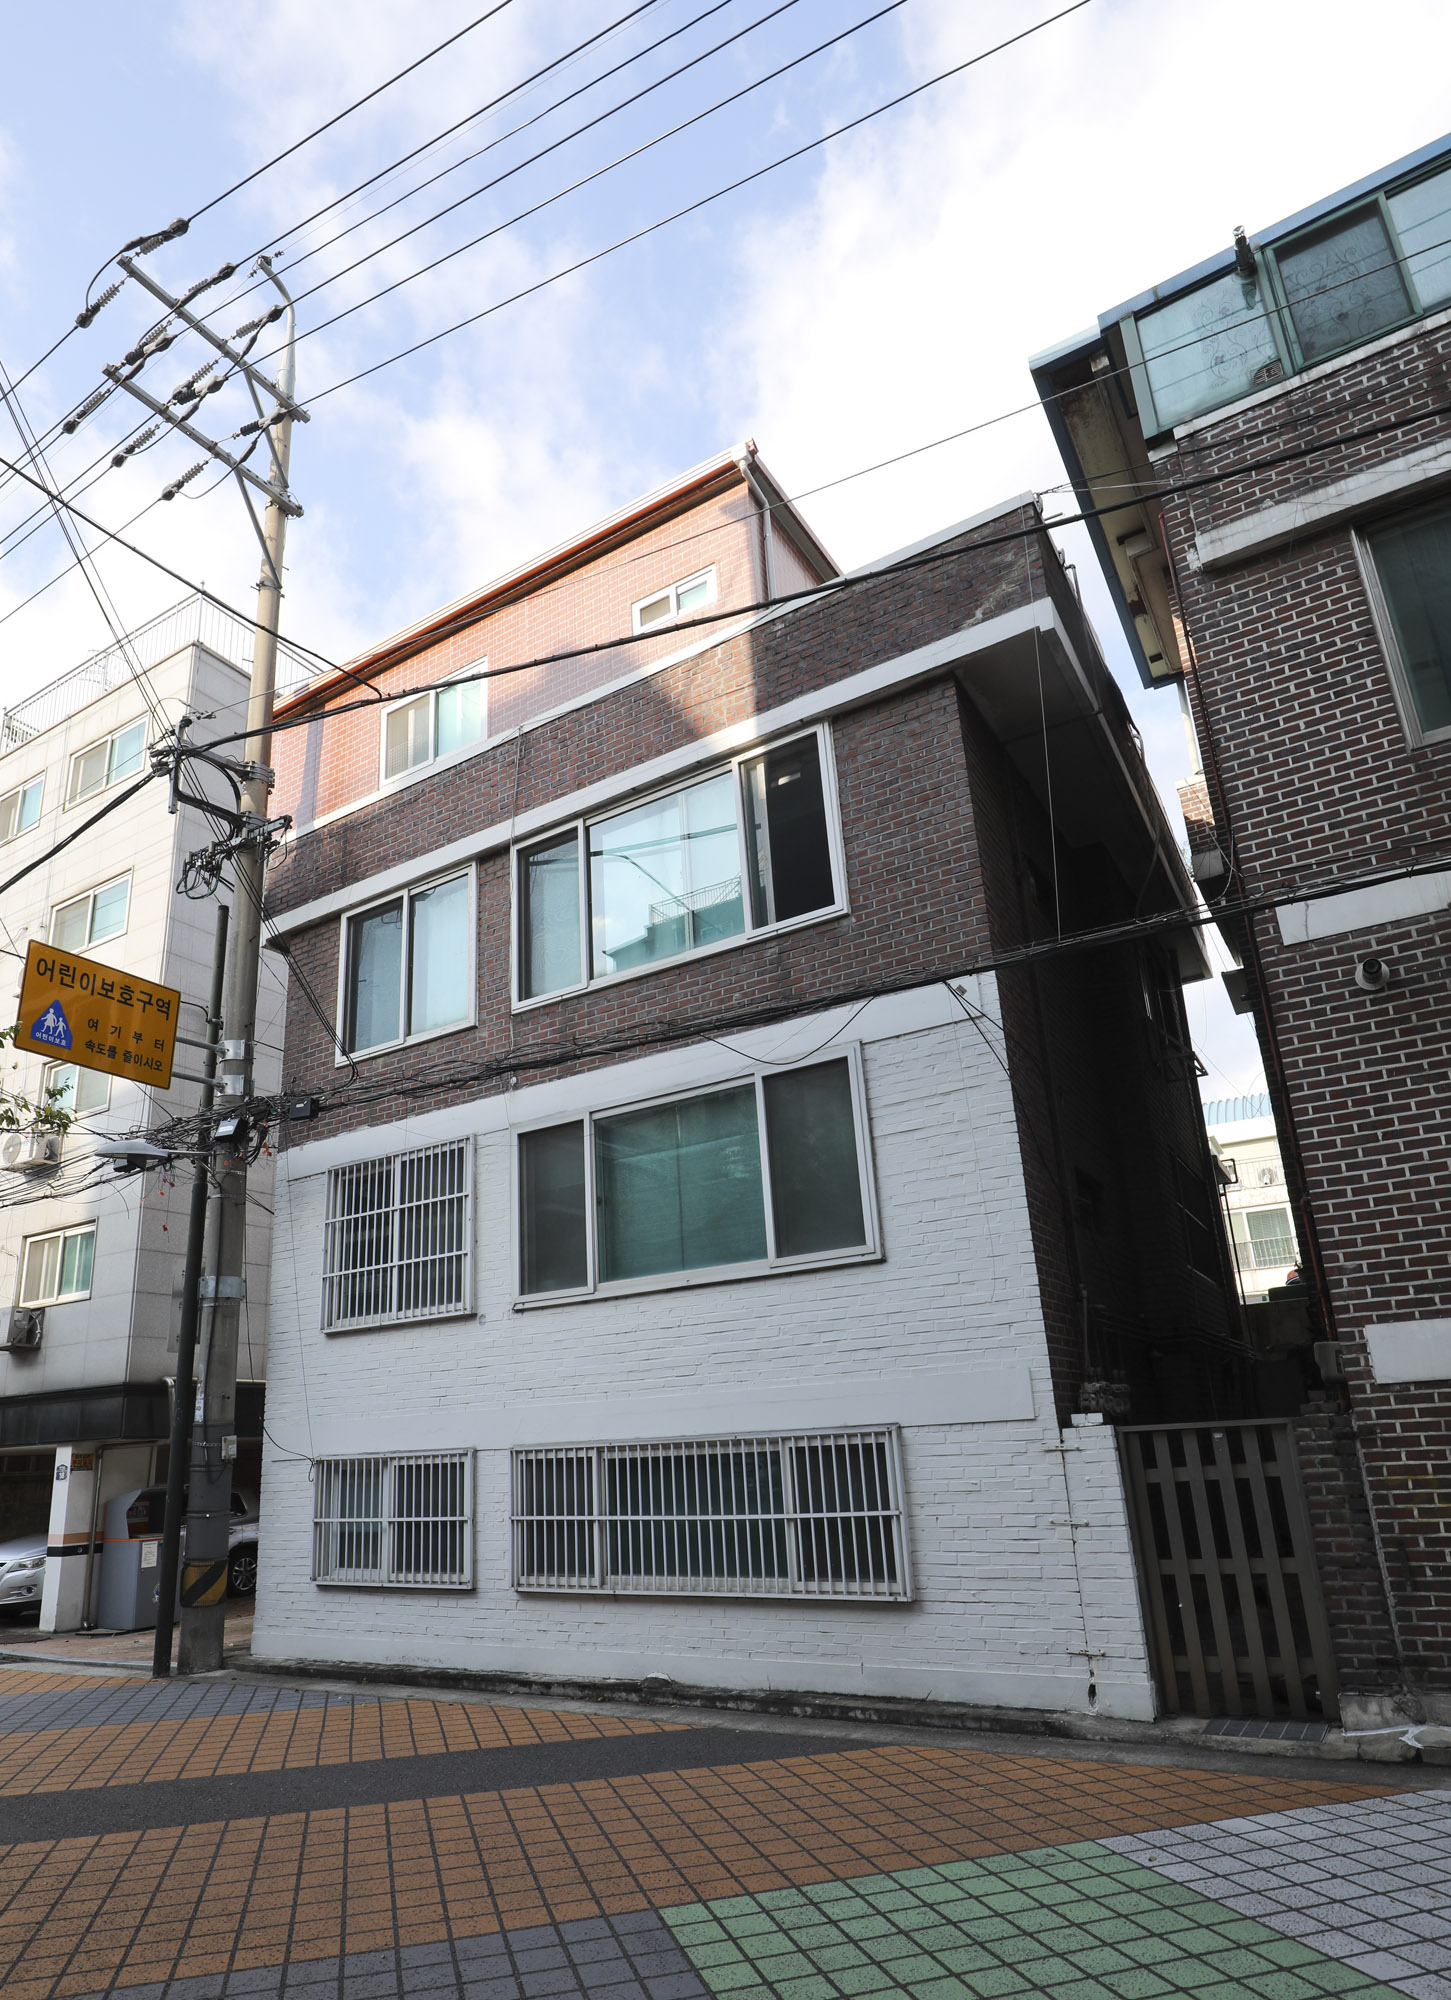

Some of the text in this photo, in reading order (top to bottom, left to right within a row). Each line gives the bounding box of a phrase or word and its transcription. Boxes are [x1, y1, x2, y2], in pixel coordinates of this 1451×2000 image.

[36, 958, 171, 1021] 어린이보호구역
[84, 1040, 163, 1072] 속도를 줄이시오
